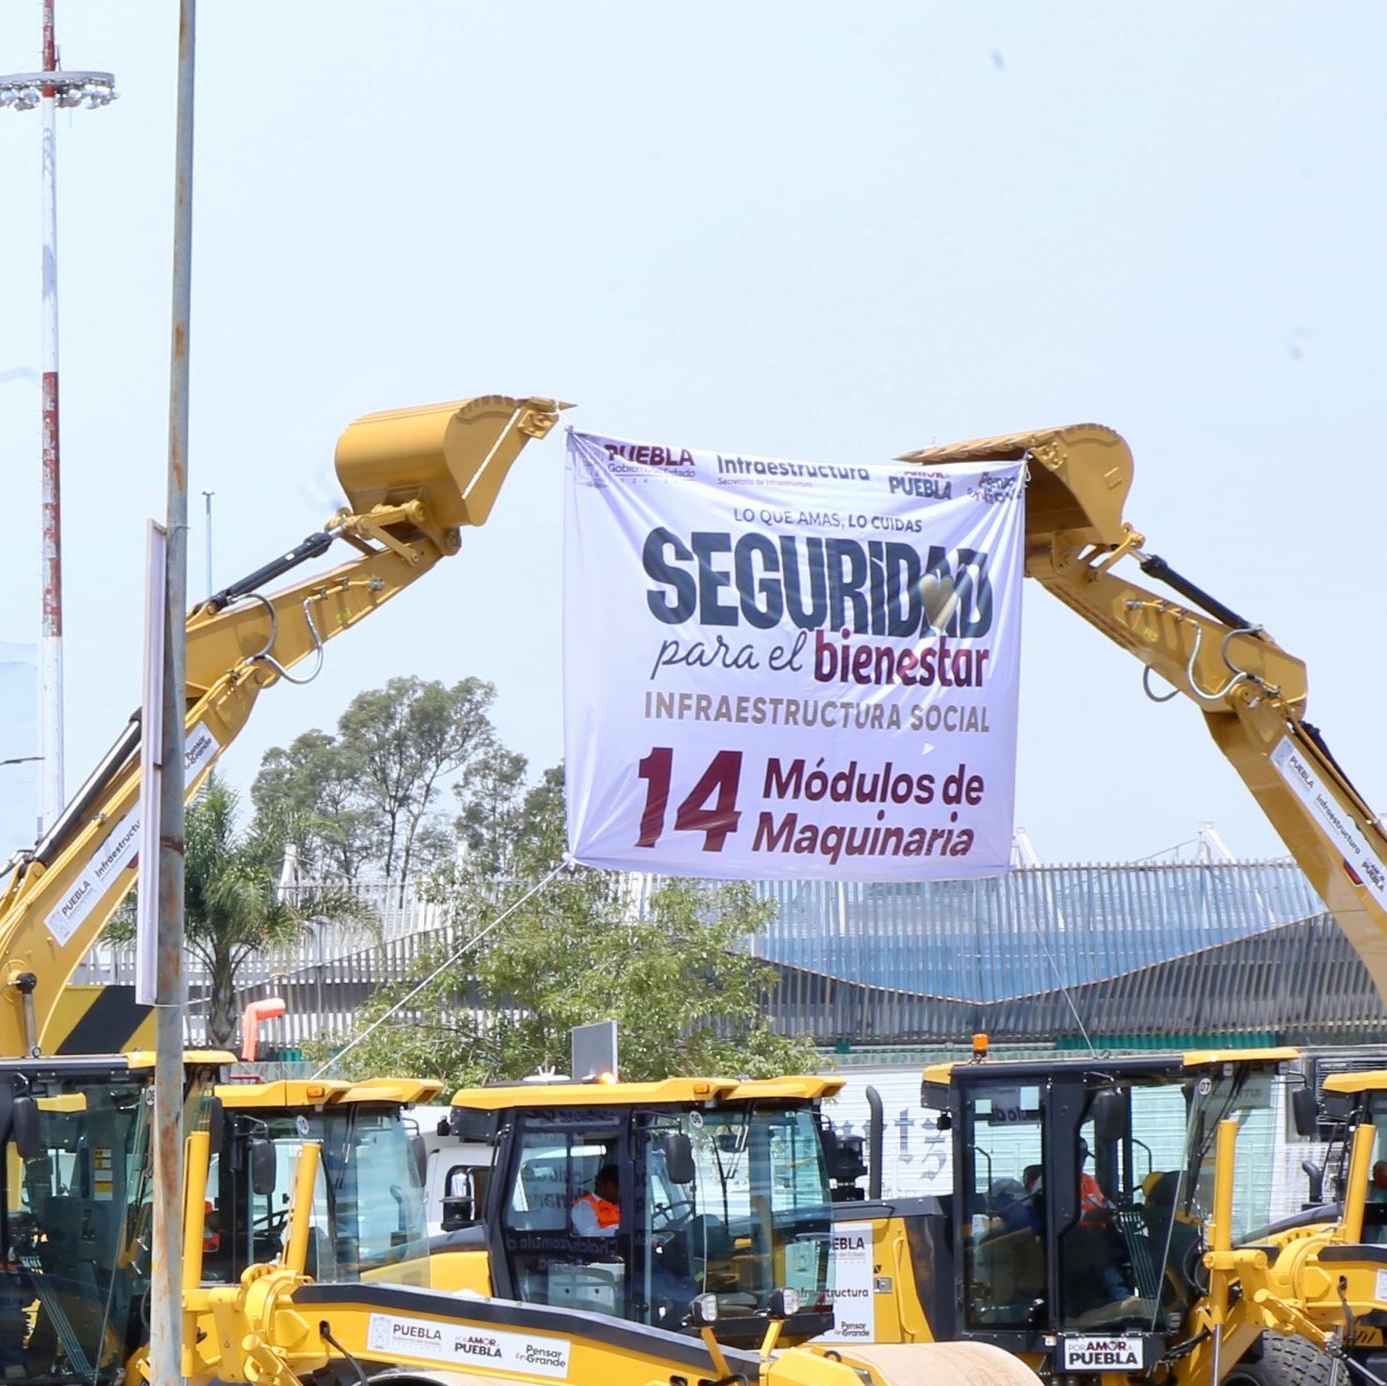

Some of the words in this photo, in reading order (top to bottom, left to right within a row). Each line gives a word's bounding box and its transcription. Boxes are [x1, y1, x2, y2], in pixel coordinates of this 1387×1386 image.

[604, 444, 695, 466] PUEBLA
[717, 455, 870, 480] Infraestructura
[889, 476, 952, 500] PUEBLA
[734, 508, 755, 522] LO
[760, 509, 793, 526] QUE
[798, 511, 844, 530] AMAS,
[848, 514, 867, 528] LO
[871, 516, 922, 533] CUIDAS
[642, 526, 994, 638] SEGURIDAD
[650, 637, 760, 680] para
[769, 631, 807, 672] el
[814, 628, 990, 687] bienestar
[644, 691, 901, 730] INFRAESTRUCTURA
[910, 704, 990, 733] SOCIAL
[763, 757, 935, 804] Módulos
[942, 763, 984, 806] de
[1289, 755, 1315, 789] PUEBLA
[634, 747, 743, 853] 14
[1316, 794, 1362, 855] Infraestructura
[752, 809, 975, 866] Maquinaria
[60, 880, 91, 917] PUEBLA
[833, 1238, 865, 1250] EBLA
[393, 1323, 442, 1341] PUEBLA
[455, 1342, 503, 1358] PUEBLA
[525, 1344, 562, 1359] Pensar
[1069, 1352, 1138, 1365] PUEBLA
[1087, 1341, 1126, 1351] AMOR
[526, 1354, 566, 1369] Grande
